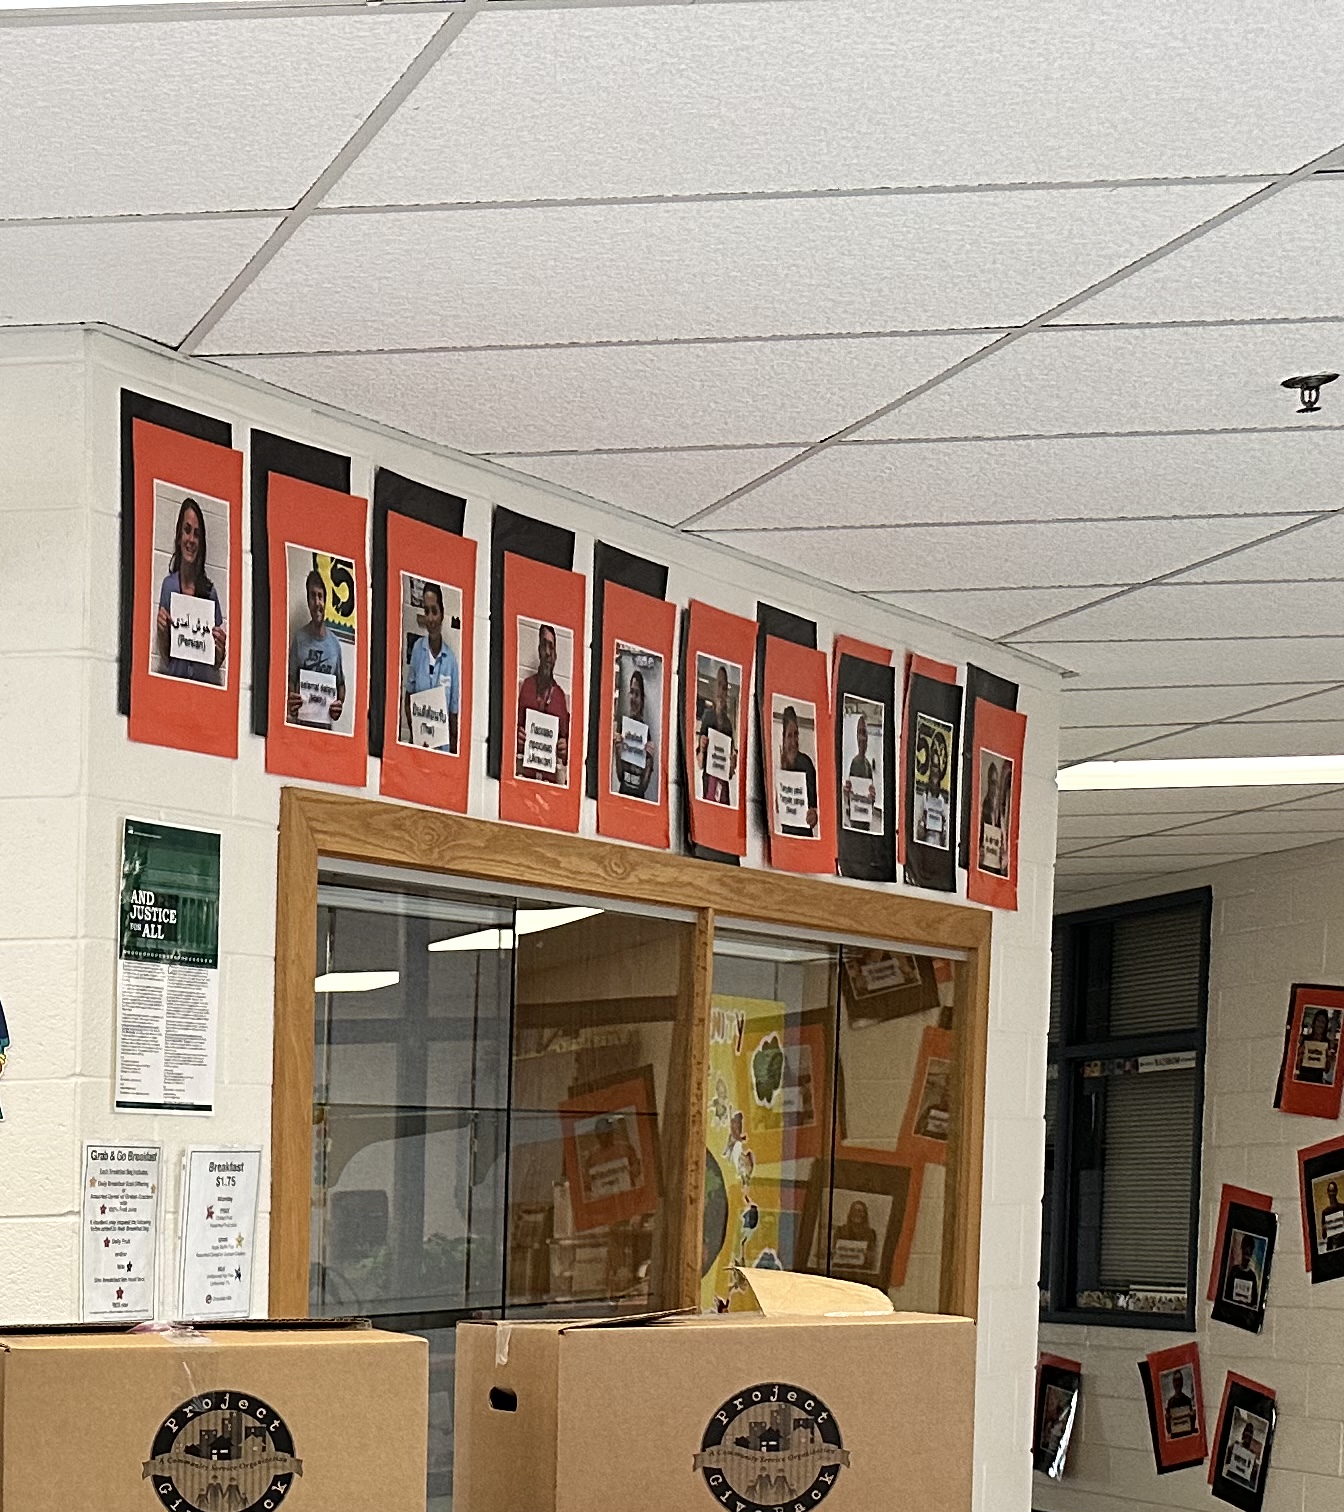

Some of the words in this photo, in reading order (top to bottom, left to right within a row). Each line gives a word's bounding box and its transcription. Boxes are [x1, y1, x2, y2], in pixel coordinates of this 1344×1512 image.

[130, 889, 155, 906] AND
[130, 905, 177, 924] JUSTICE
[141, 924, 165, 939] ALL
[91, 1150, 109, 1161] Grab
[109, 1150, 115, 1161] &
[116, 1150, 127, 1161] Go
[208, 1161, 245, 1173] Breakfast
[215, 1175, 236, 1187] $1.75
[164, 1392, 282, 1433] Project
[715, 1385, 830, 1425] Project
